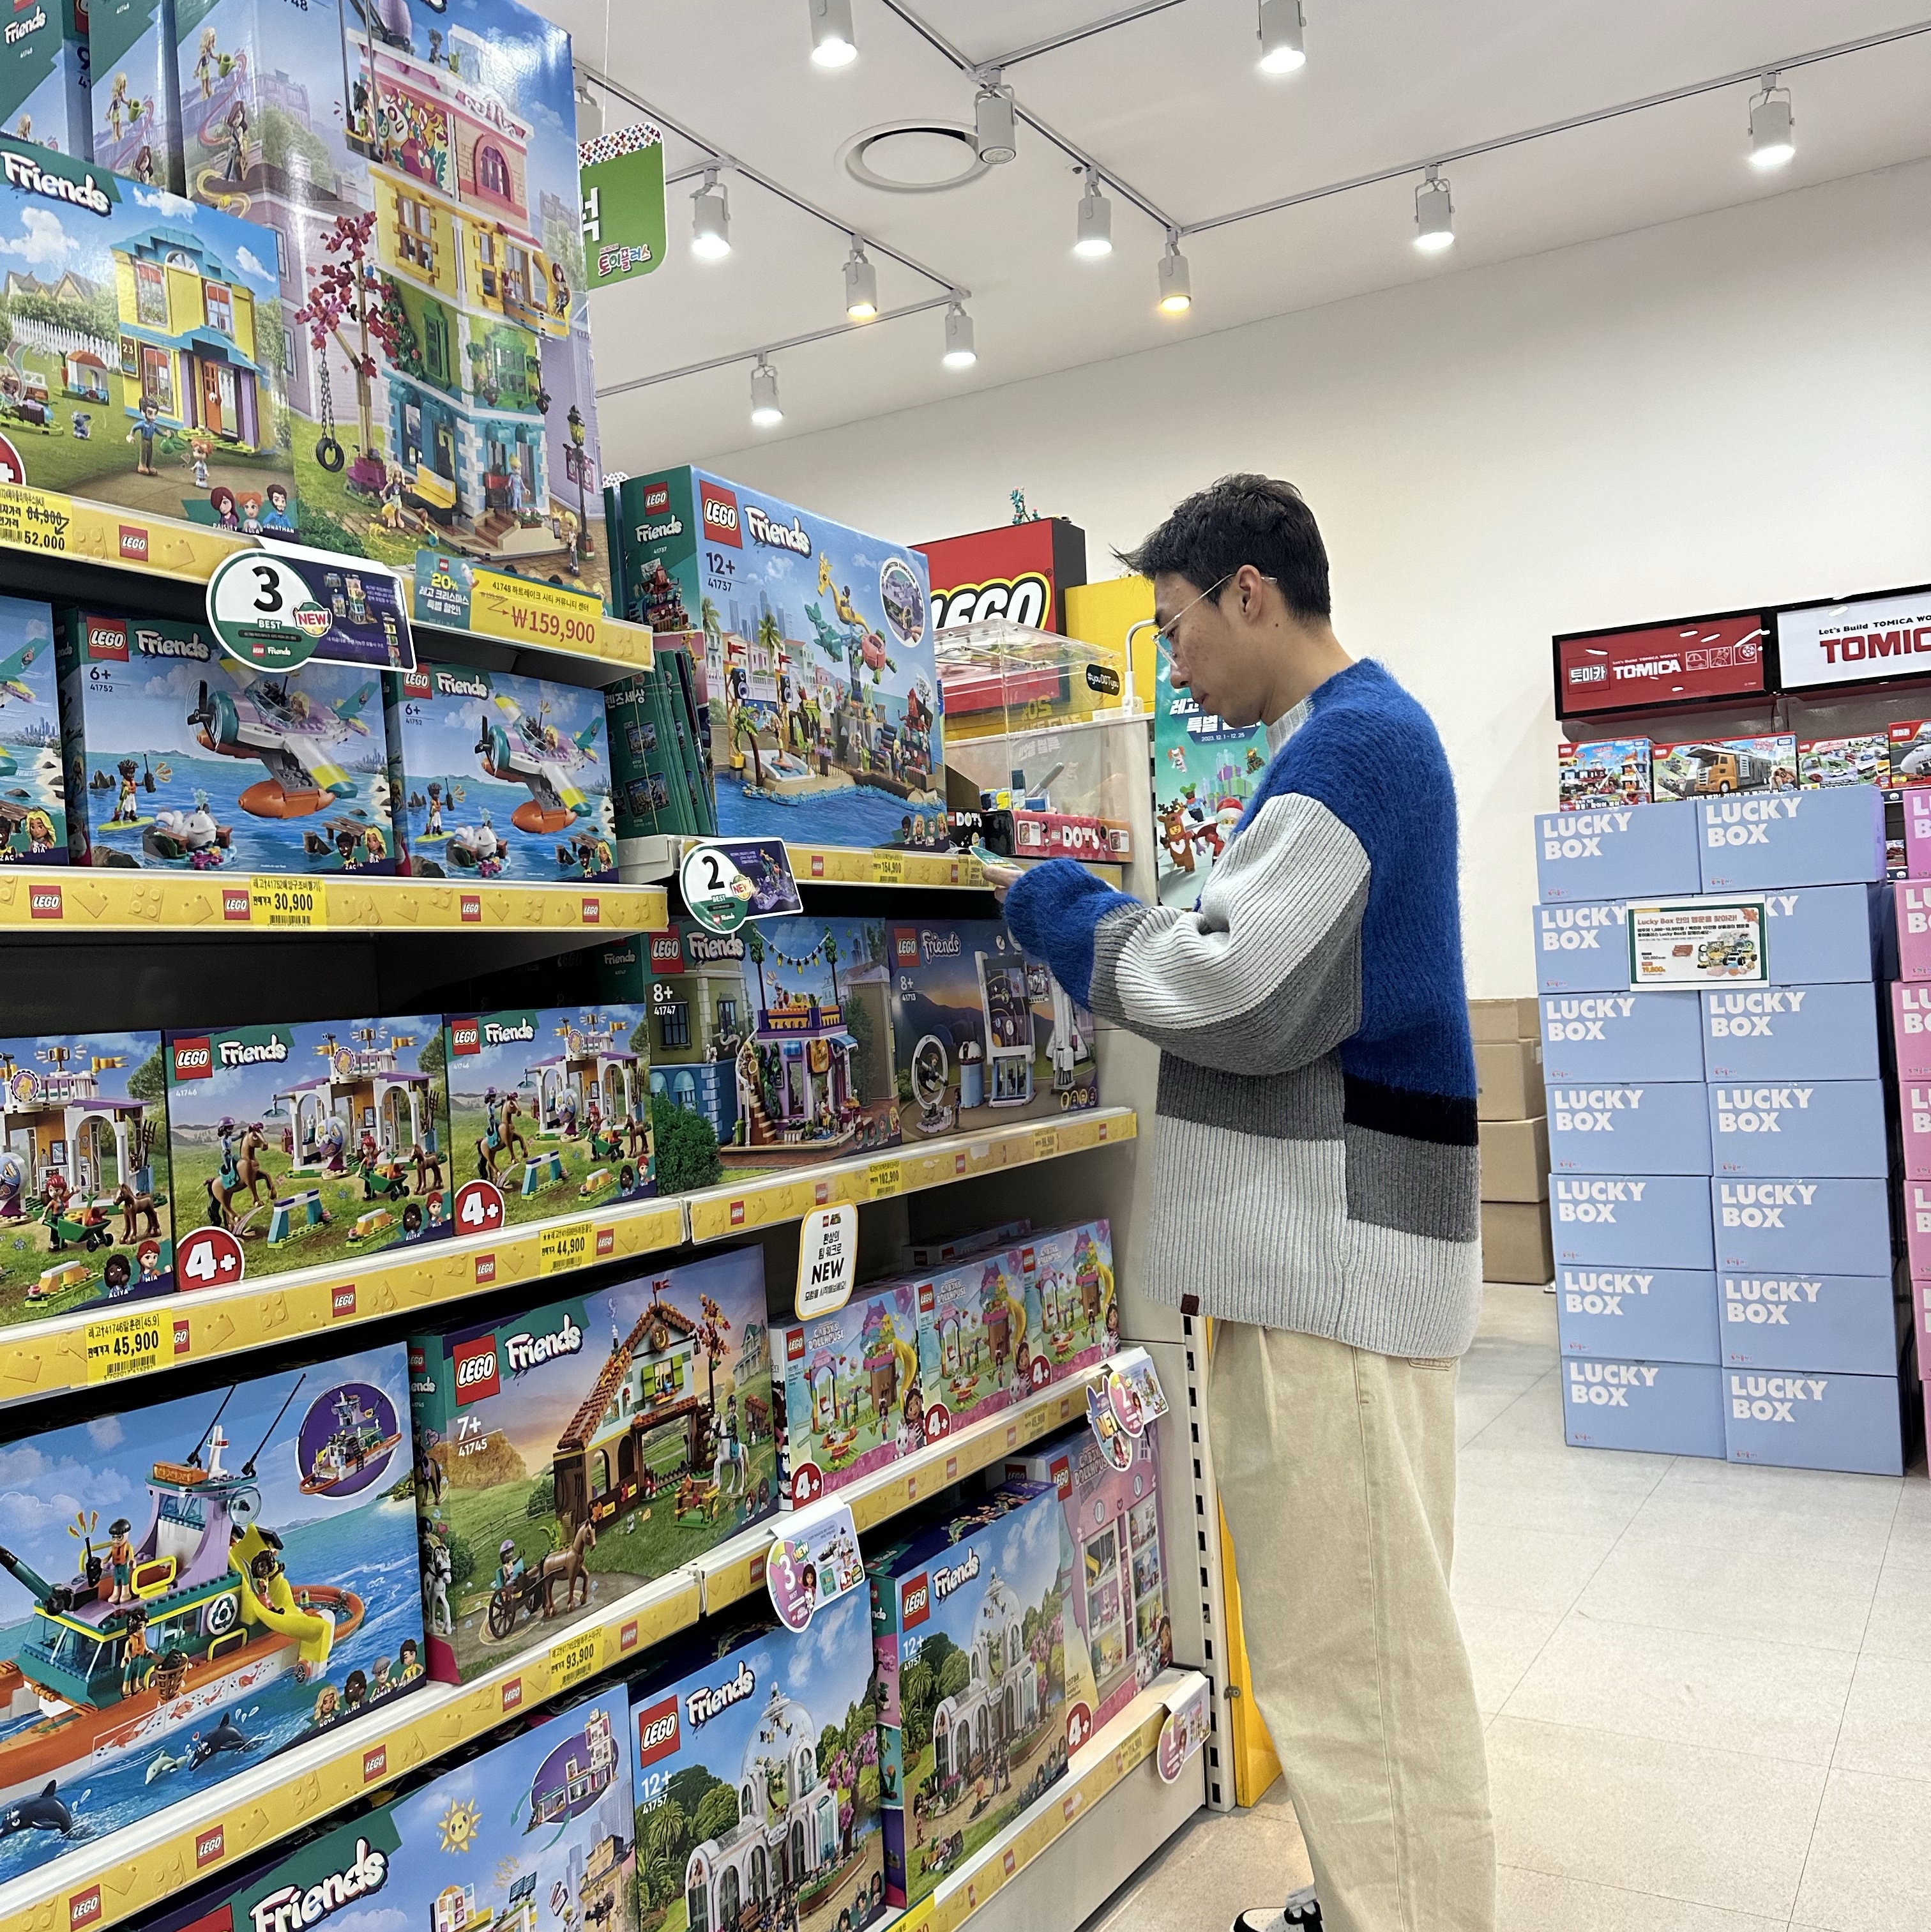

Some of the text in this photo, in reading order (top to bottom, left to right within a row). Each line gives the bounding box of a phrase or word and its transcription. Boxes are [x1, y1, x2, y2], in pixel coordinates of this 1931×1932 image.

[4, 6, 47, 44] Friends
[3, 153, 110, 213] Friends
[599, 245, 651, 275] 토이플러스
[646, 490, 667, 508] LEGO
[264, 523, 294, 533] JONATHAN
[635, 515, 683, 543] Friends
[705, 499, 812, 558] LEGO Friends
[706, 552, 736, 575] 12+
[252, 566, 283, 612] 3
[431, 573, 458, 591] 20%
[708, 577, 732, 592] 41737
[419, 586, 469, 606] 레고 크리스마스
[492, 581, 589, 612] 41748 하트레이크 시티 커뮤니티 센터
[259, 620, 281, 630] BEST
[298, 613, 326, 625] NEW
[511, 606, 595, 644] ₩159,900
[1844, 623, 1868, 632] Build
[1873, 617, 1914, 628] TOMICA
[90, 628, 209, 660] LEGO Friends
[268, 646, 291, 656] Friends
[89, 667, 111, 681] 6+
[1570, 666, 1607, 683] 토미카
[1612, 659, 1682, 680] TOMICA
[90, 684, 114, 693] 41752
[404, 671, 488, 698] LEGO Friends
[405, 703, 420, 717] 6+
[405, 718, 423, 727] 41752
[1186, 715, 1218, 733] 특별
[956, 812, 982, 828] DOTS
[1706, 797, 1802, 825] LUCKY
[1543, 811, 1632, 839] LUCKY
[1708, 823, 1769, 848] BOX
[1063, 826, 1100, 850] DOTS
[1545, 837, 1603, 860] BOX
[702, 856, 725, 890] 2
[275, 893, 313, 913] 30,900
[1541, 906, 1626, 930] LUCKY
[653, 929, 744, 959] LEGO Friends
[897, 931, 960, 957] LEGO Friends
[1543, 930, 1600, 951] BOX
[653, 984, 673, 1002] 8+
[900, 975, 914, 991] 8+
[654, 1005, 676, 1015] 41747
[1546, 998, 1635, 1019] LUCKY
[1709, 992, 1806, 1015] LUCKY
[453, 1019, 534, 1046] LEGO Friends
[1548, 1020, 1606, 1042] BOX
[1711, 1015, 1773, 1037] BOX
[176, 1035, 287, 1067] LEGO Friends
[1554, 1090, 1644, 1110] LUCKY
[1717, 1088, 1814, 1110] LUCKY
[1556, 1112, 1614, 1132] BOX
[1718, 1111, 1781, 1132] BOX
[461, 1192, 499, 1226] 4+
[557, 1236, 585, 1256] 44,900
[823, 1230, 840, 1245] 환상의
[185, 1241, 236, 1279] 4+
[819, 1247, 824, 1260] 팀
[811, 1258, 844, 1285] NEW
[109, 1288, 129, 1298] ALIYA
[920, 1293, 934, 1304] LEGO
[936, 1286, 967, 1304] DOLLHOUSE
[808, 1330, 845, 1351] DOLLHOUSE
[814, 1322, 839, 1339] GABBY'S
[114, 1330, 159, 1357] 45,900
[457, 1314, 582, 1385] LEGO Friends
[788, 1337, 803, 1352] LEGO
[1031, 1362, 1050, 1384] 4+
[1570, 1362, 1659, 1387] LUCKY
[1116, 1383, 1132, 1408] 2
[1571, 1385, 1628, 1407] BOX
[1731, 1376, 1828, 1401] LUCKY
[1732, 1399, 1795, 1422] BOX
[457, 1415, 481, 1441] 7+
[929, 1410, 949, 1434] 4+
[458, 1440, 487, 1458] 41745
[796, 1469, 821, 1500] 4+
[1054, 1468, 1068, 1487] LEGO
[794, 1542, 809, 1561] NEW
[778, 1554, 796, 1591] 3
[904, 1547, 980, 1615] LEGO Friends
[566, 1643, 594, 1670] 93,900
[903, 1634, 925, 1658] 12+
[904, 1655, 921, 1671] 41757
[344, 1703, 361, 1716] ALIYA
[642, 1661, 755, 1750] LEGO Friends
[319, 1716, 335, 1728] NOVA
[1068, 1713, 1089, 1747] 4+
[642, 1769, 674, 1800] 12+
[642, 1796, 669, 1815] 41757
[250, 1839, 387, 1932] Friends
